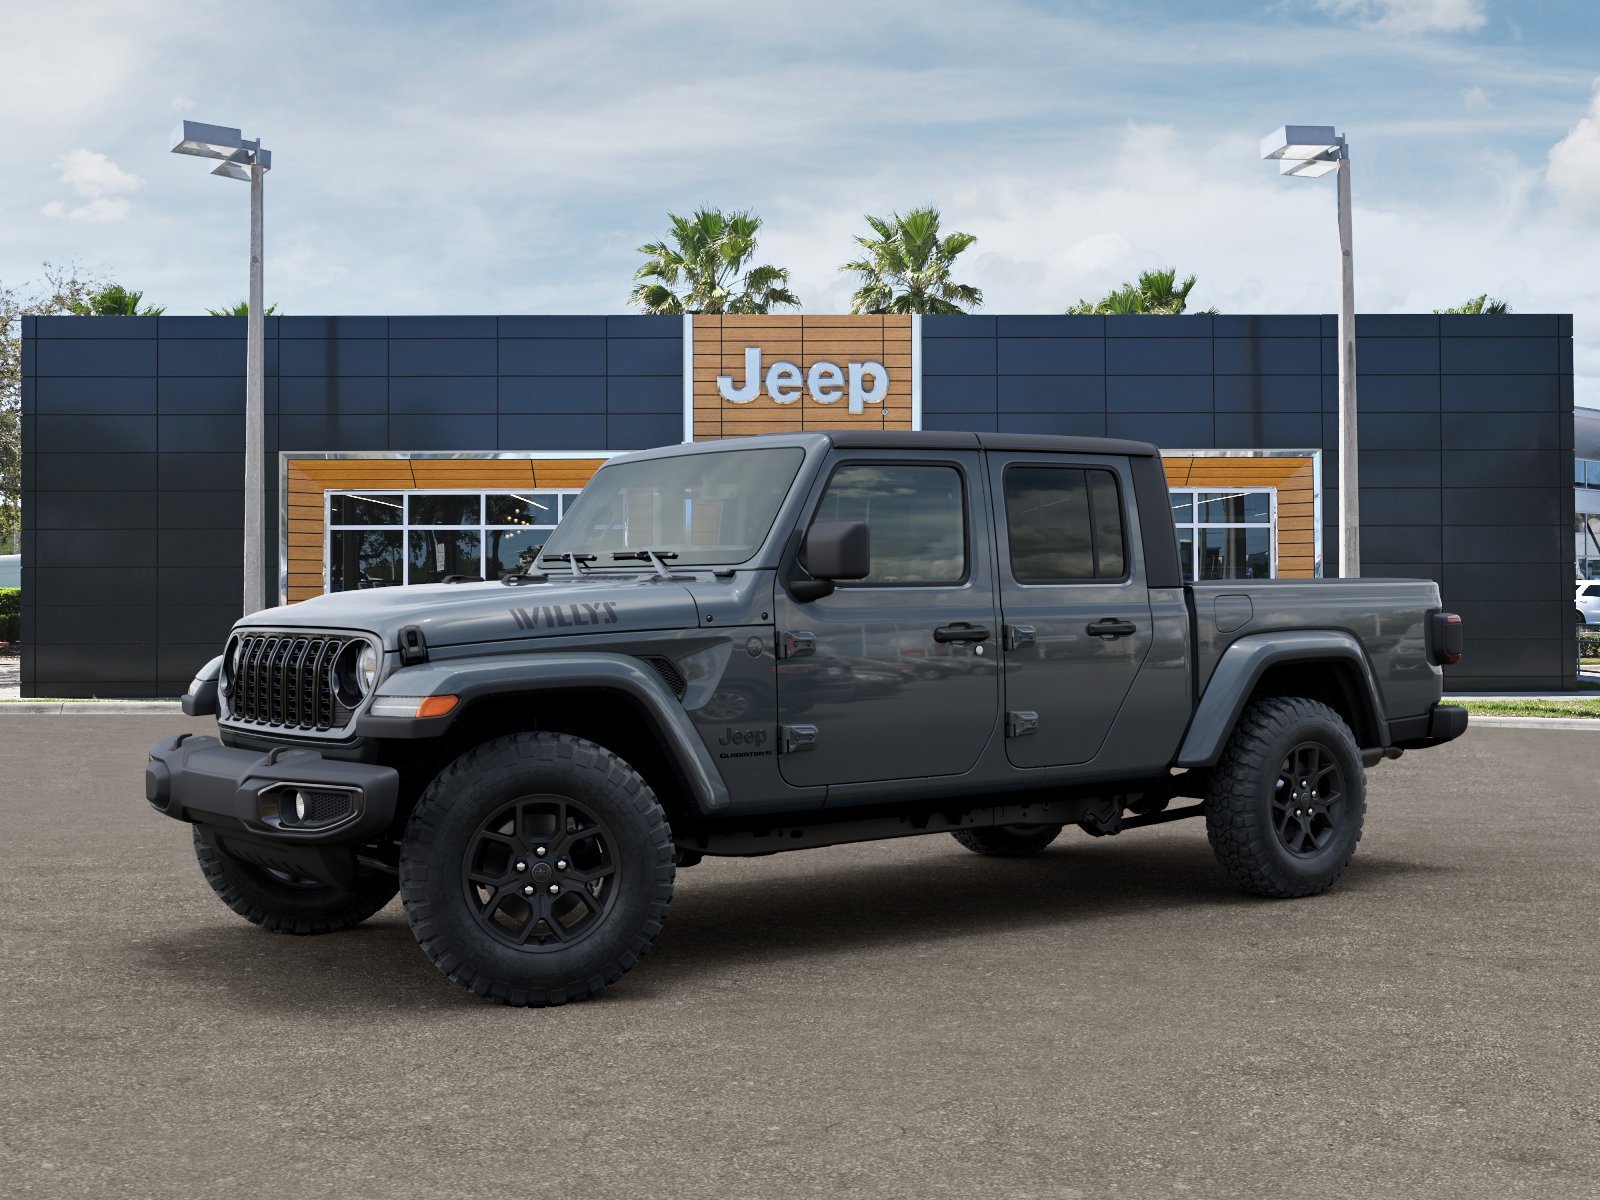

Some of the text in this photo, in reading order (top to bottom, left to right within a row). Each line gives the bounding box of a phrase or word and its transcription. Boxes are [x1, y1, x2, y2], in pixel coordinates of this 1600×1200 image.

[716, 347, 890, 415] Jeep
[509, 601, 618, 630] WILLYS
[718, 727, 768, 747] Jeep
[719, 751, 765, 759] GLADIATOR
